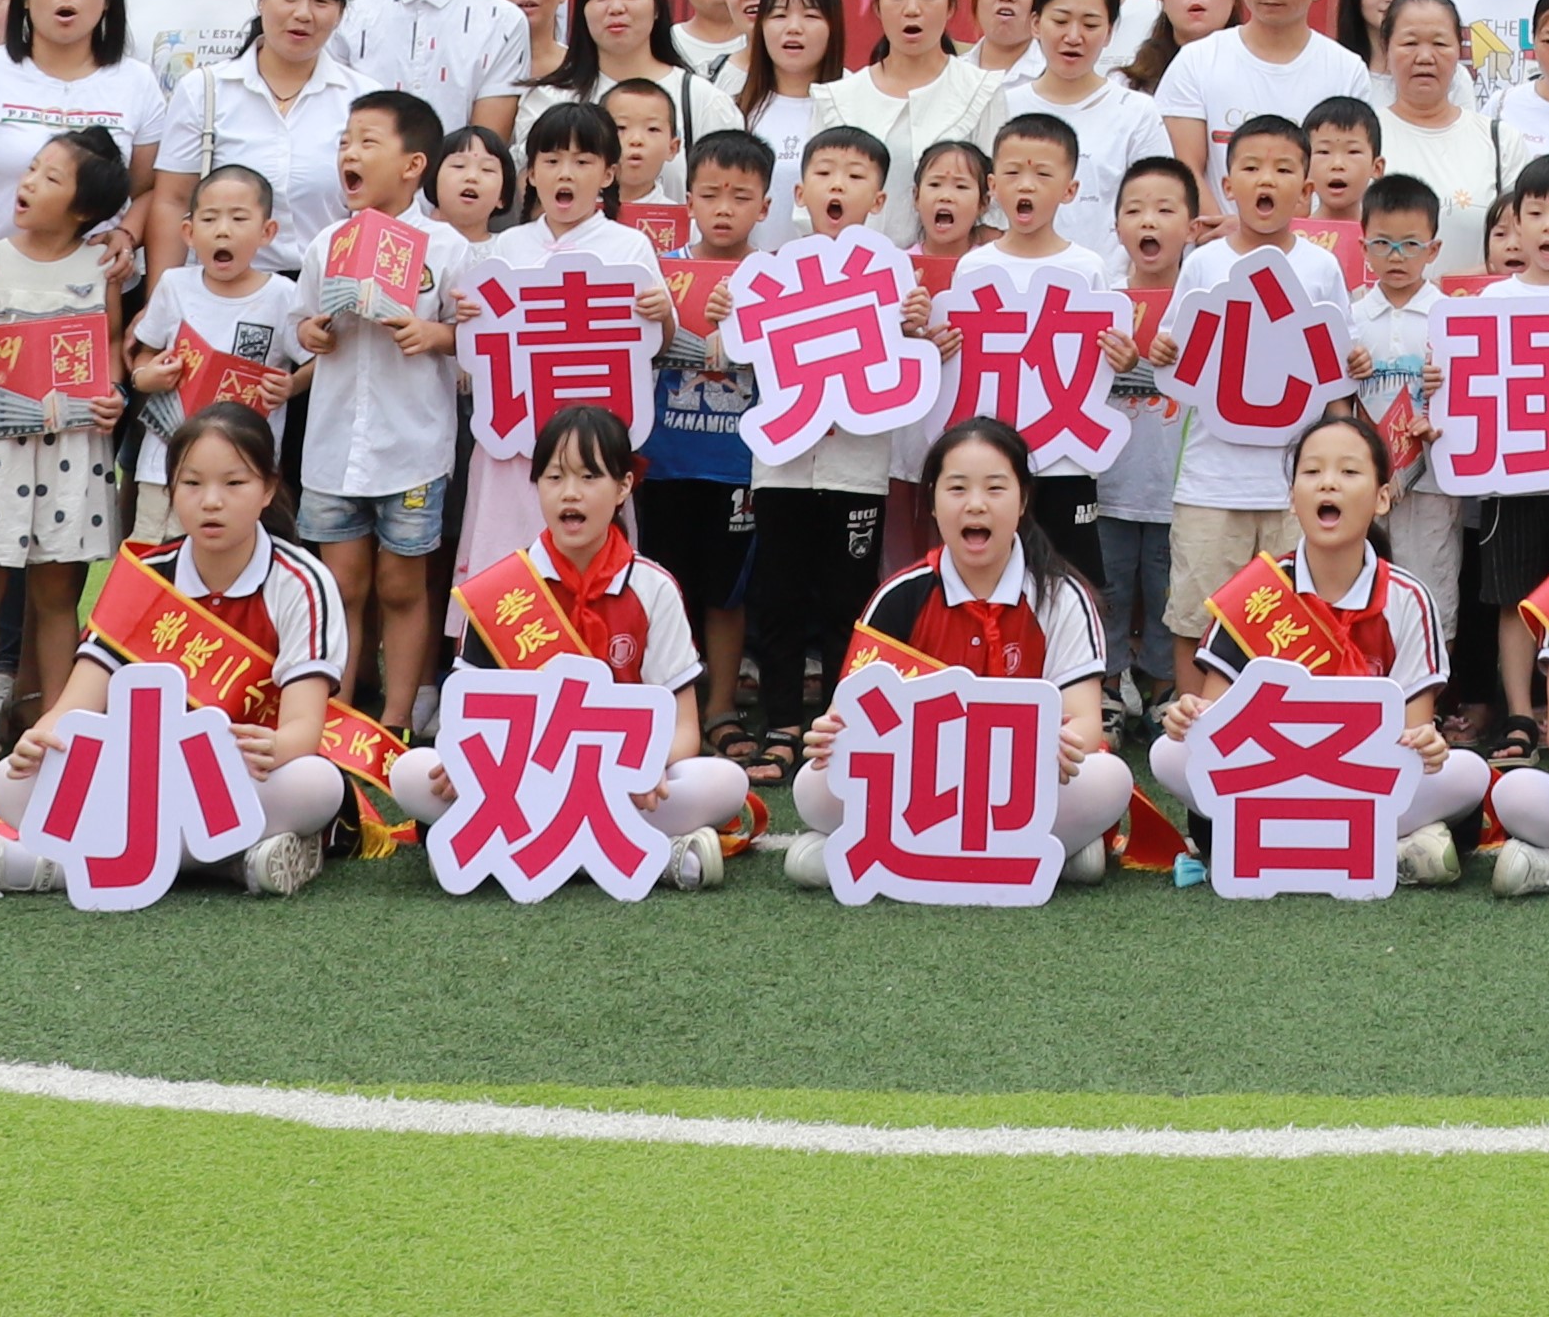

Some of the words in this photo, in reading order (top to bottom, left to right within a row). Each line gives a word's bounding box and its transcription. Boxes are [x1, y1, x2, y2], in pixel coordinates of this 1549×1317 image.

[7, 109, 121, 125] PERFECTION
[475, 271, 641, 440] 请
[736, 246, 921, 445] 党
[947, 283, 1114, 453] 放
[1173, 267, 1344, 428] 心
[42, 687, 240, 889] 小
[450, 678, 654, 880] 欢
[845, 686, 1041, 885] 迎
[1208, 681, 1401, 880] 各
